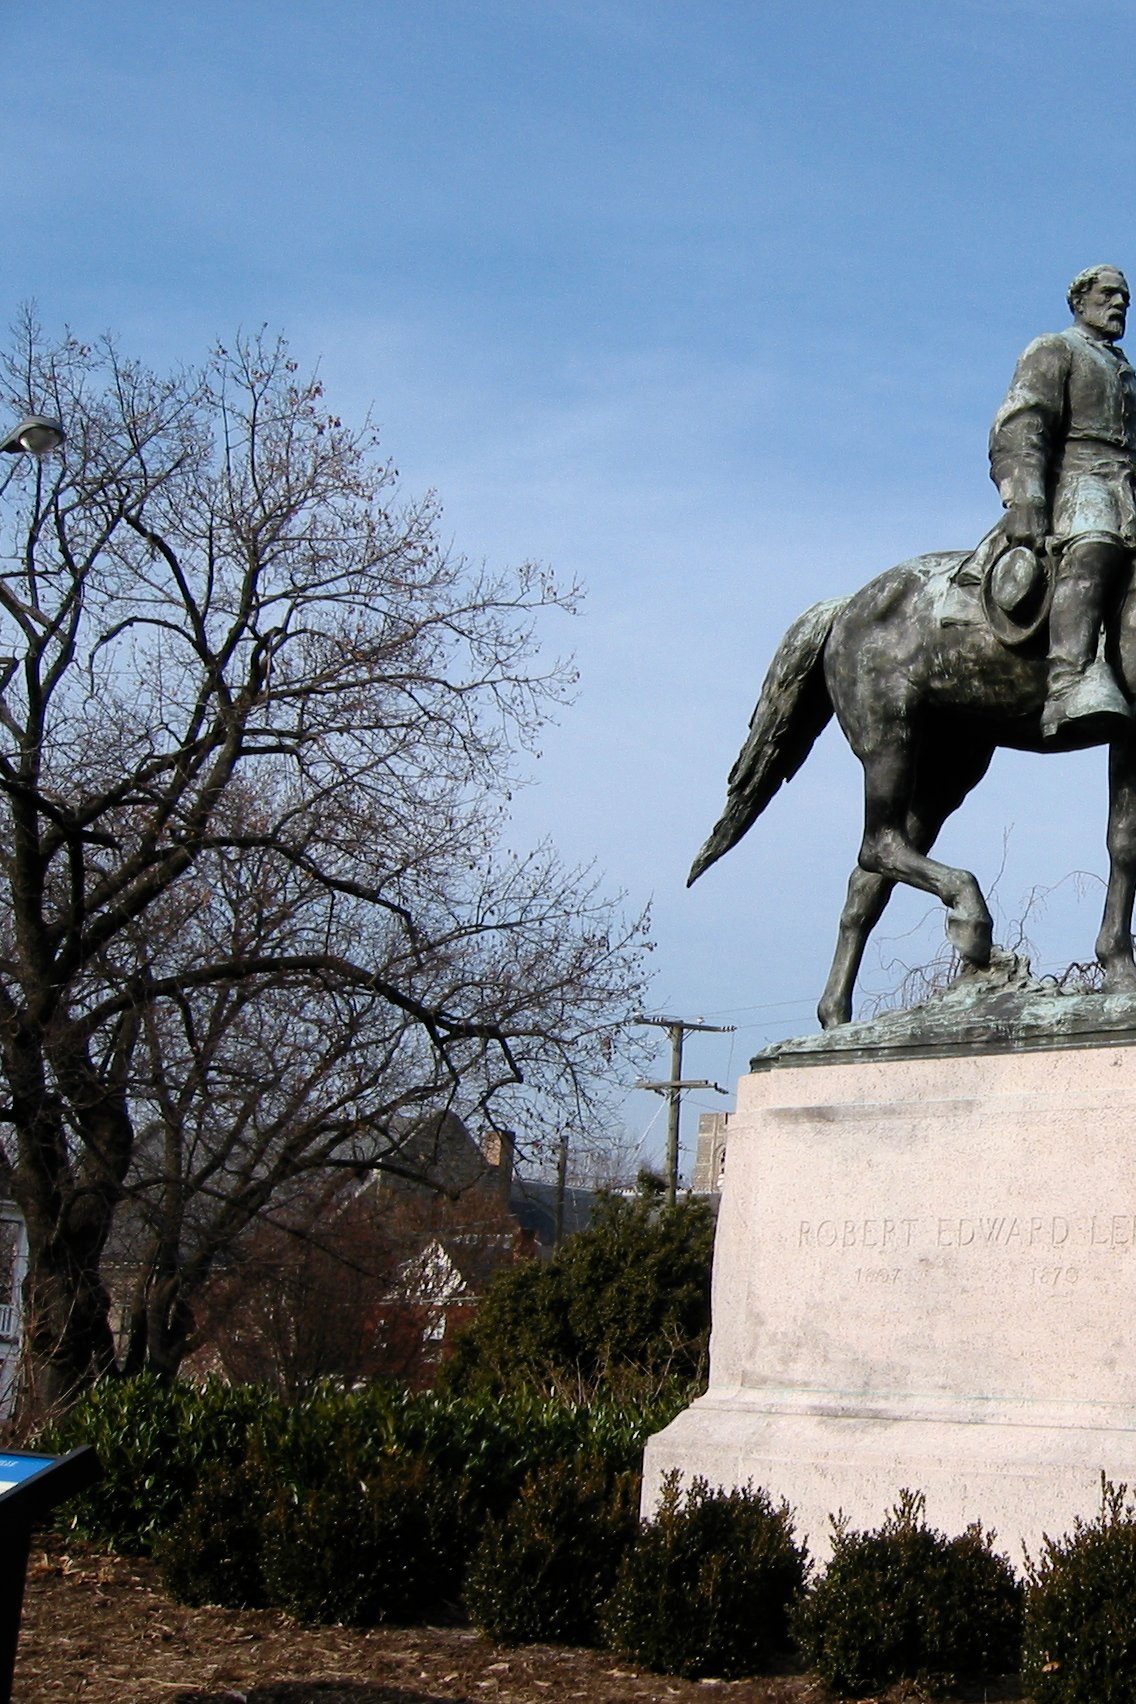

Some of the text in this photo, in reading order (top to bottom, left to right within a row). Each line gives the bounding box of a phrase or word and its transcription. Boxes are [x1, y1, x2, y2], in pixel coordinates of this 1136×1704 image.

[798, 1218, 919, 1247] ROBERT
[935, 1215, 1070, 1247] EDWARD
[1030, 1266, 1080, 1286] 1870
